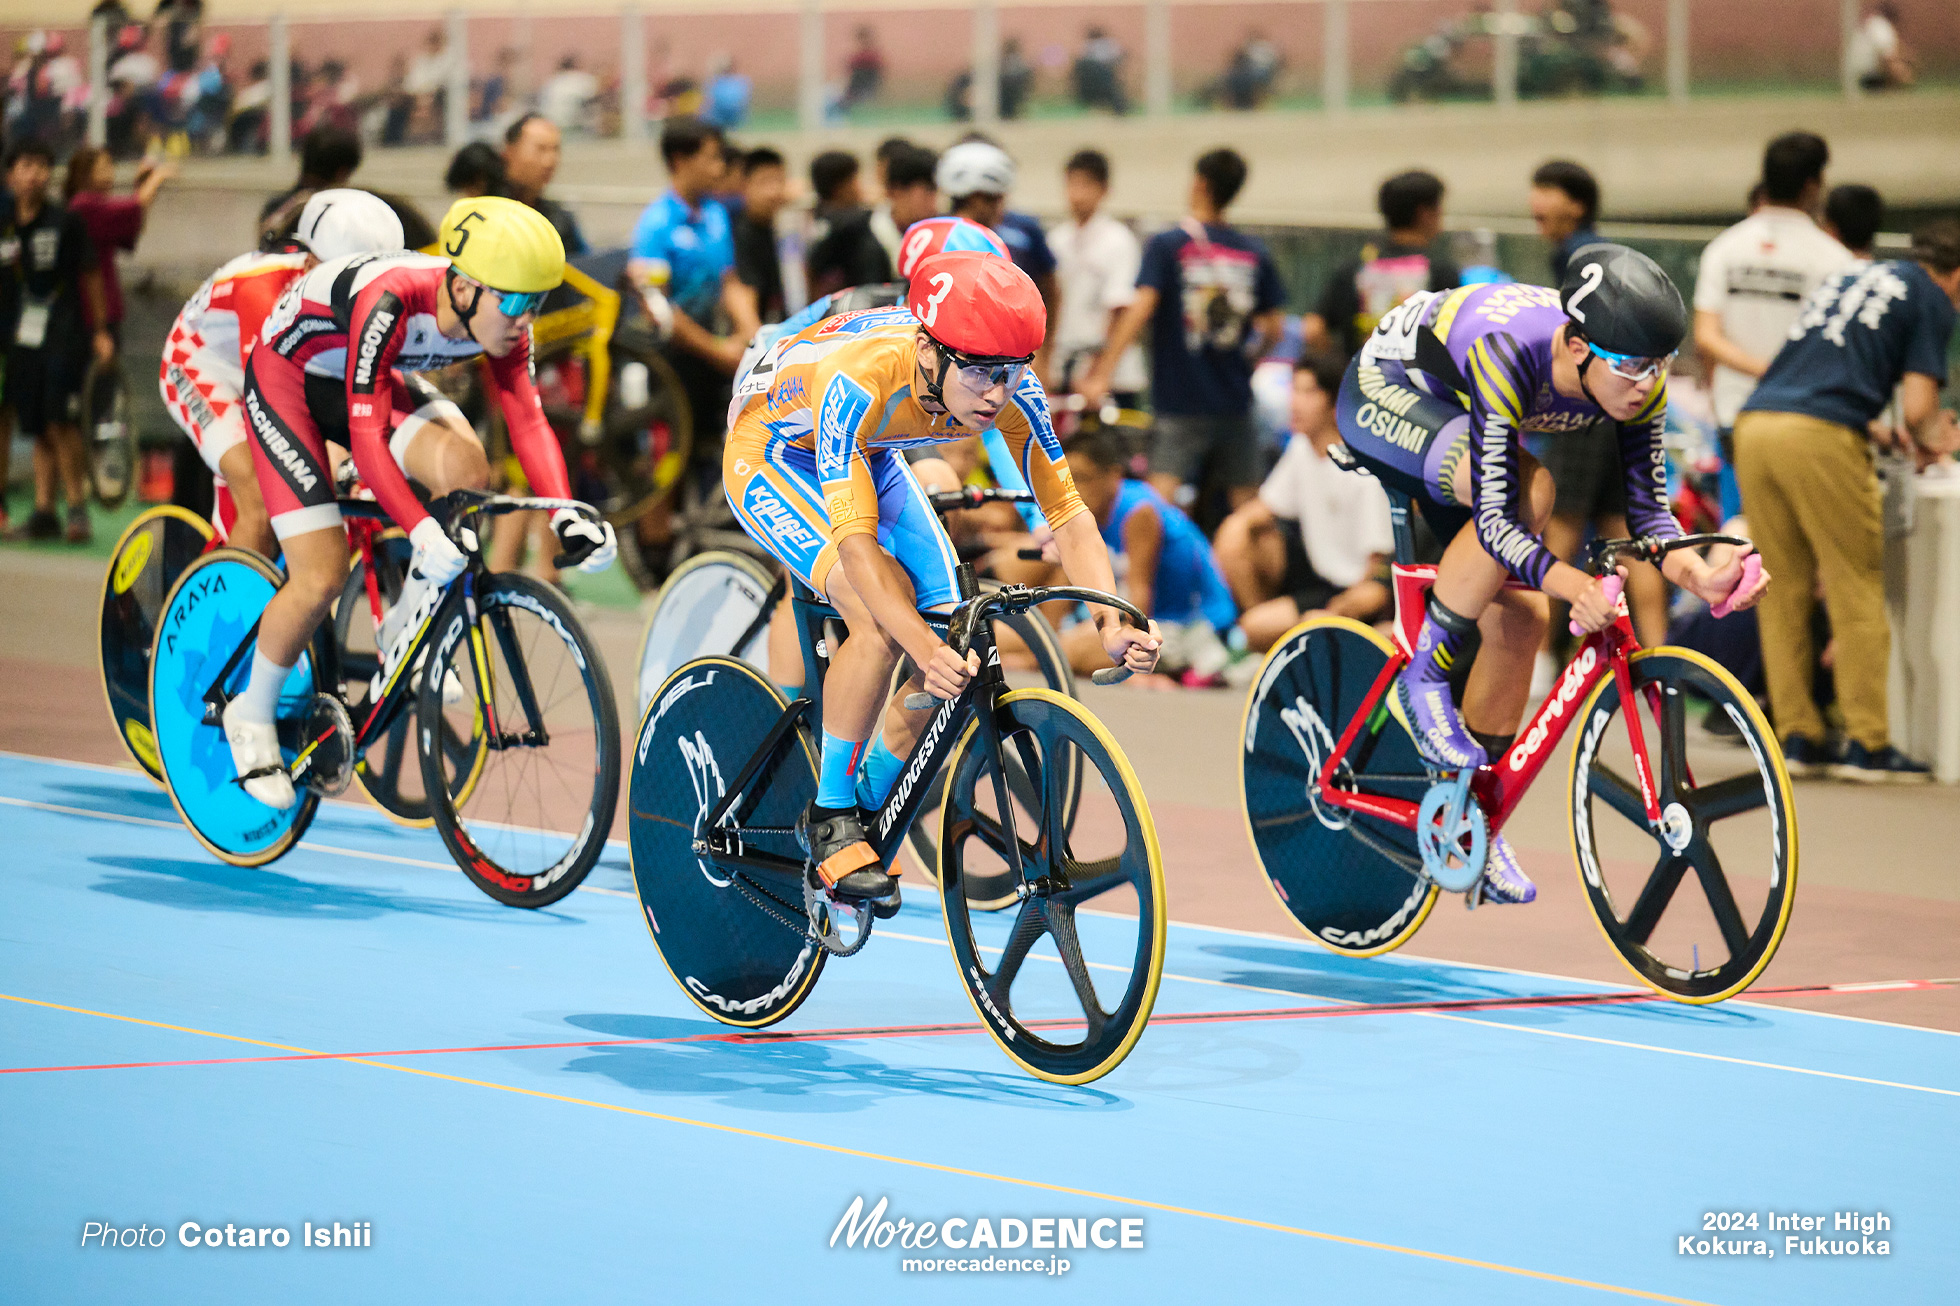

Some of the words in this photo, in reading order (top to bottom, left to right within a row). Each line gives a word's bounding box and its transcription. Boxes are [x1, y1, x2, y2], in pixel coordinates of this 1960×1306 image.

[310, 203, 334, 240] 1
[446, 211, 487, 258] 5
[903, 228, 934, 277] 9
[917, 272, 954, 328] 3
[1567, 262, 1604, 324] 2
[355, 310, 395, 385] NAGOYA
[246, 388, 318, 493] TACHIBANA
[1355, 402, 1429, 455] OSUMI
[1478, 412, 1539, 569] MINAMIOSUMI
[165, 573, 229, 656] ARAYA
[638, 669, 720, 767] GHIBLI
[1508, 646, 1598, 772] cervélo
[1426, 727, 1471, 769] OSUMI
[1574, 708, 1612, 889] CORIMA
